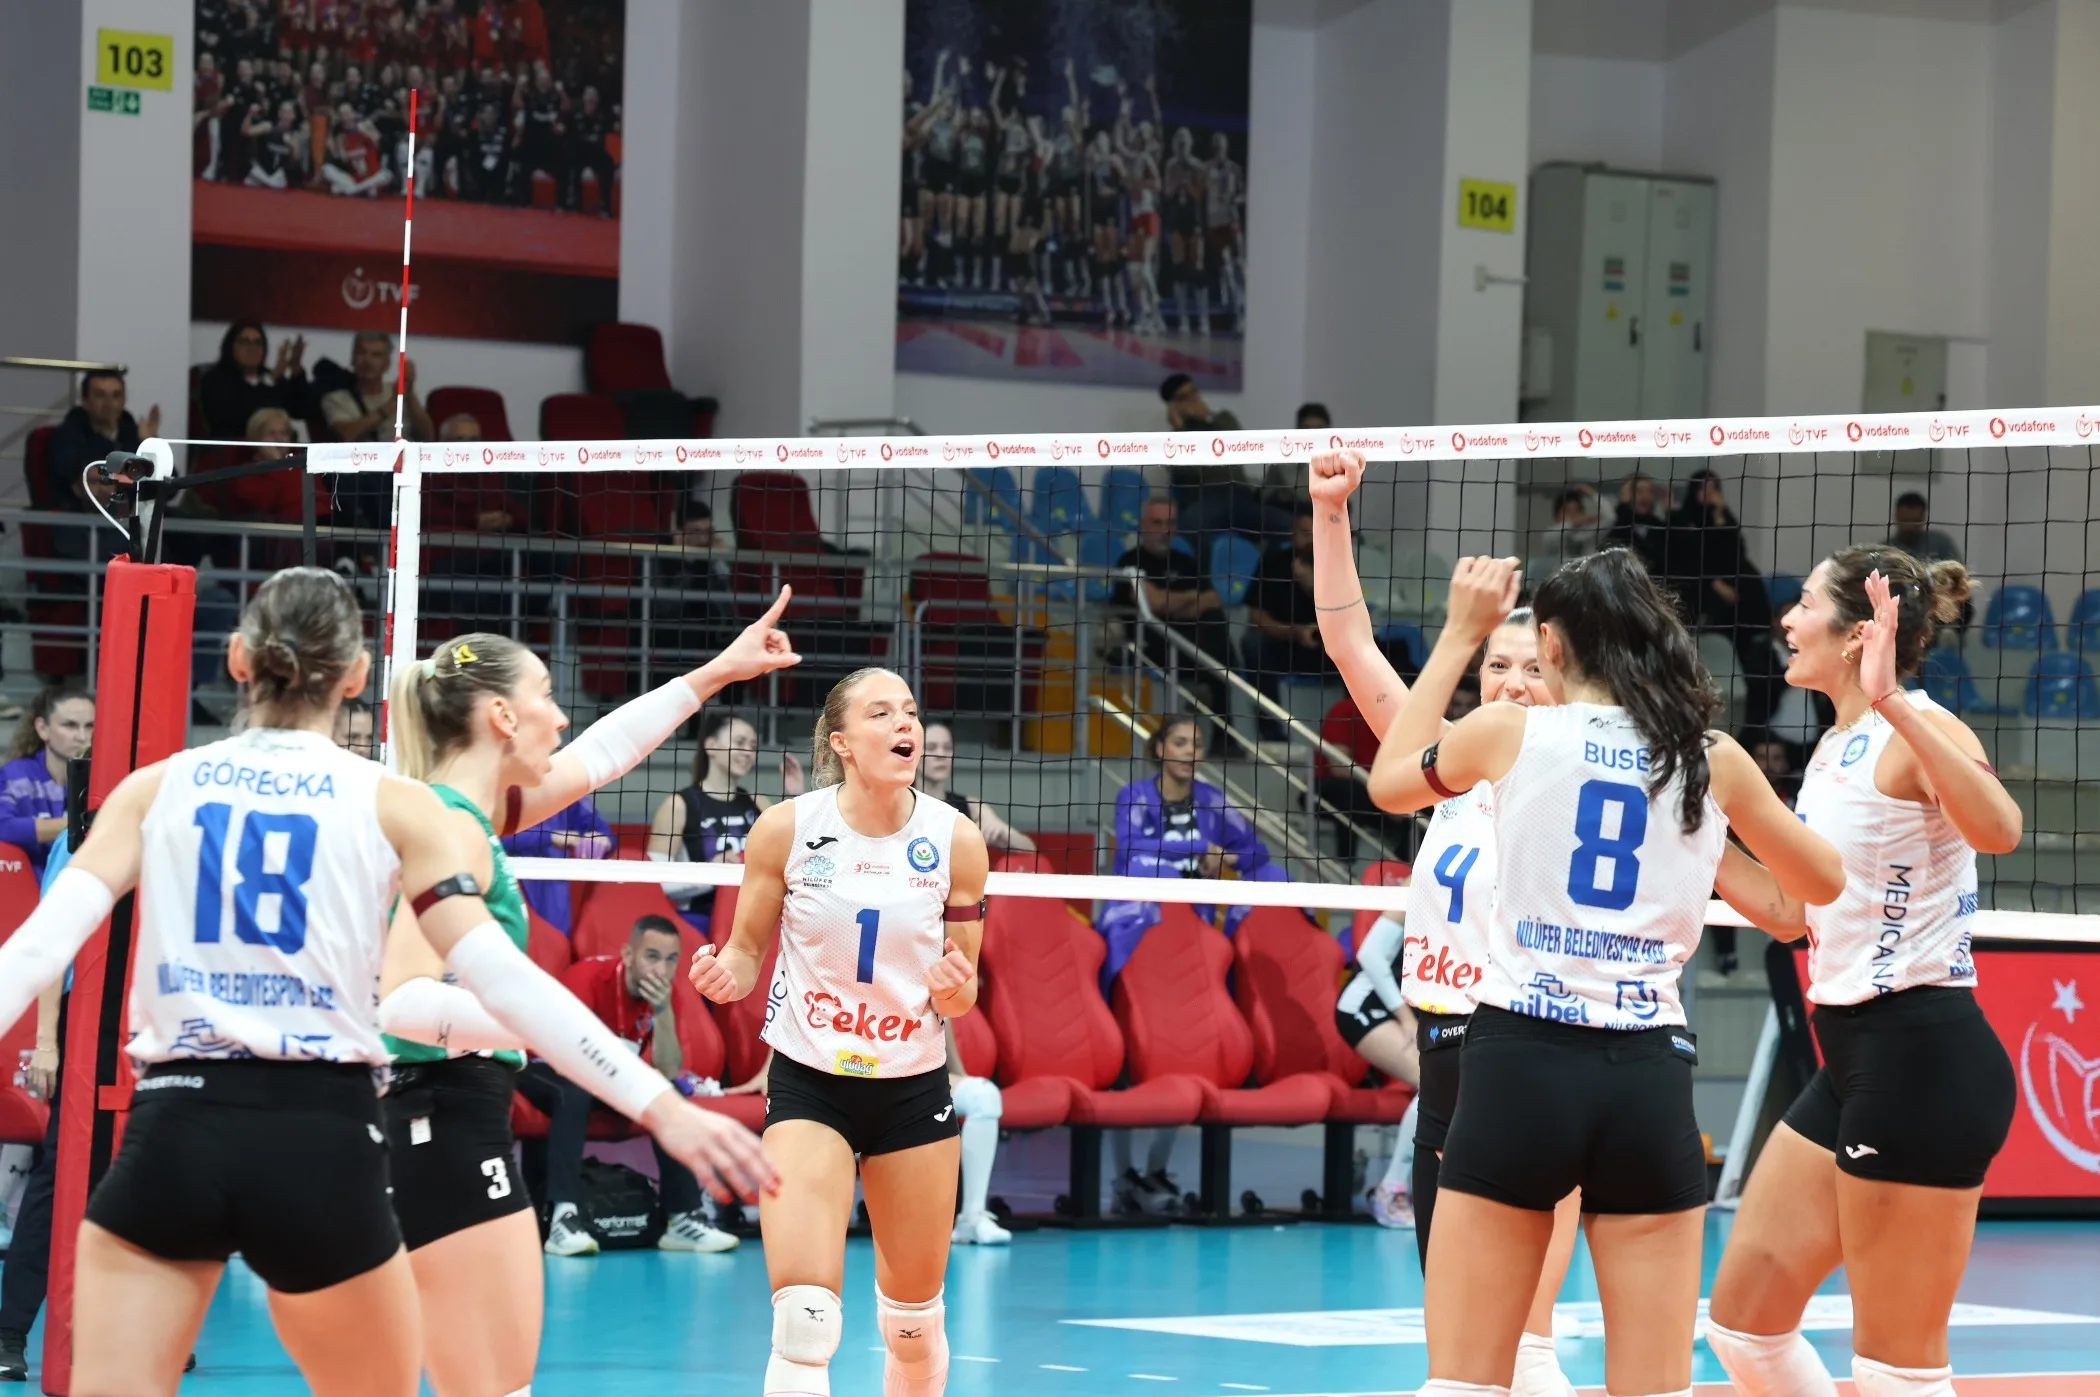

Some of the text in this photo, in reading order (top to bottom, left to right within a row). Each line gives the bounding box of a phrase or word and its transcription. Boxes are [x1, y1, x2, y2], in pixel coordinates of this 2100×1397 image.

[108, 44, 163, 78] 103
[1469, 191, 1507, 221] 104
[377, 282, 420, 304] TVF
[364, 421, 2055, 463] TVF TVF vodafone TVF vodafone TVF vodafone TVF vodafone TVF vodafone TVF vodafone TVF vodafone TVF vodafone TVF vodafone TVF vodafone TVF vodafone TVF vodafone TVF vodafone TVF vodafone
[1584, 740, 1649, 772] BUSE
[193, 758, 335, 798] GÓRECKA
[1567, 779, 1648, 911] 8
[193, 802, 319, 955] 18
[1433, 844, 1480, 923] 4
[856, 909, 880, 984] 1
[1516, 915, 1561, 954] NİLÜFER
[1564, 926, 1641, 963] BELEDİYESPOR
[1872, 864, 1913, 995] MEDICANA
[1510, 993, 1590, 1024] nilbel
[840, 1059, 875, 1075] uludağ
[480, 1157, 511, 1200] 3
